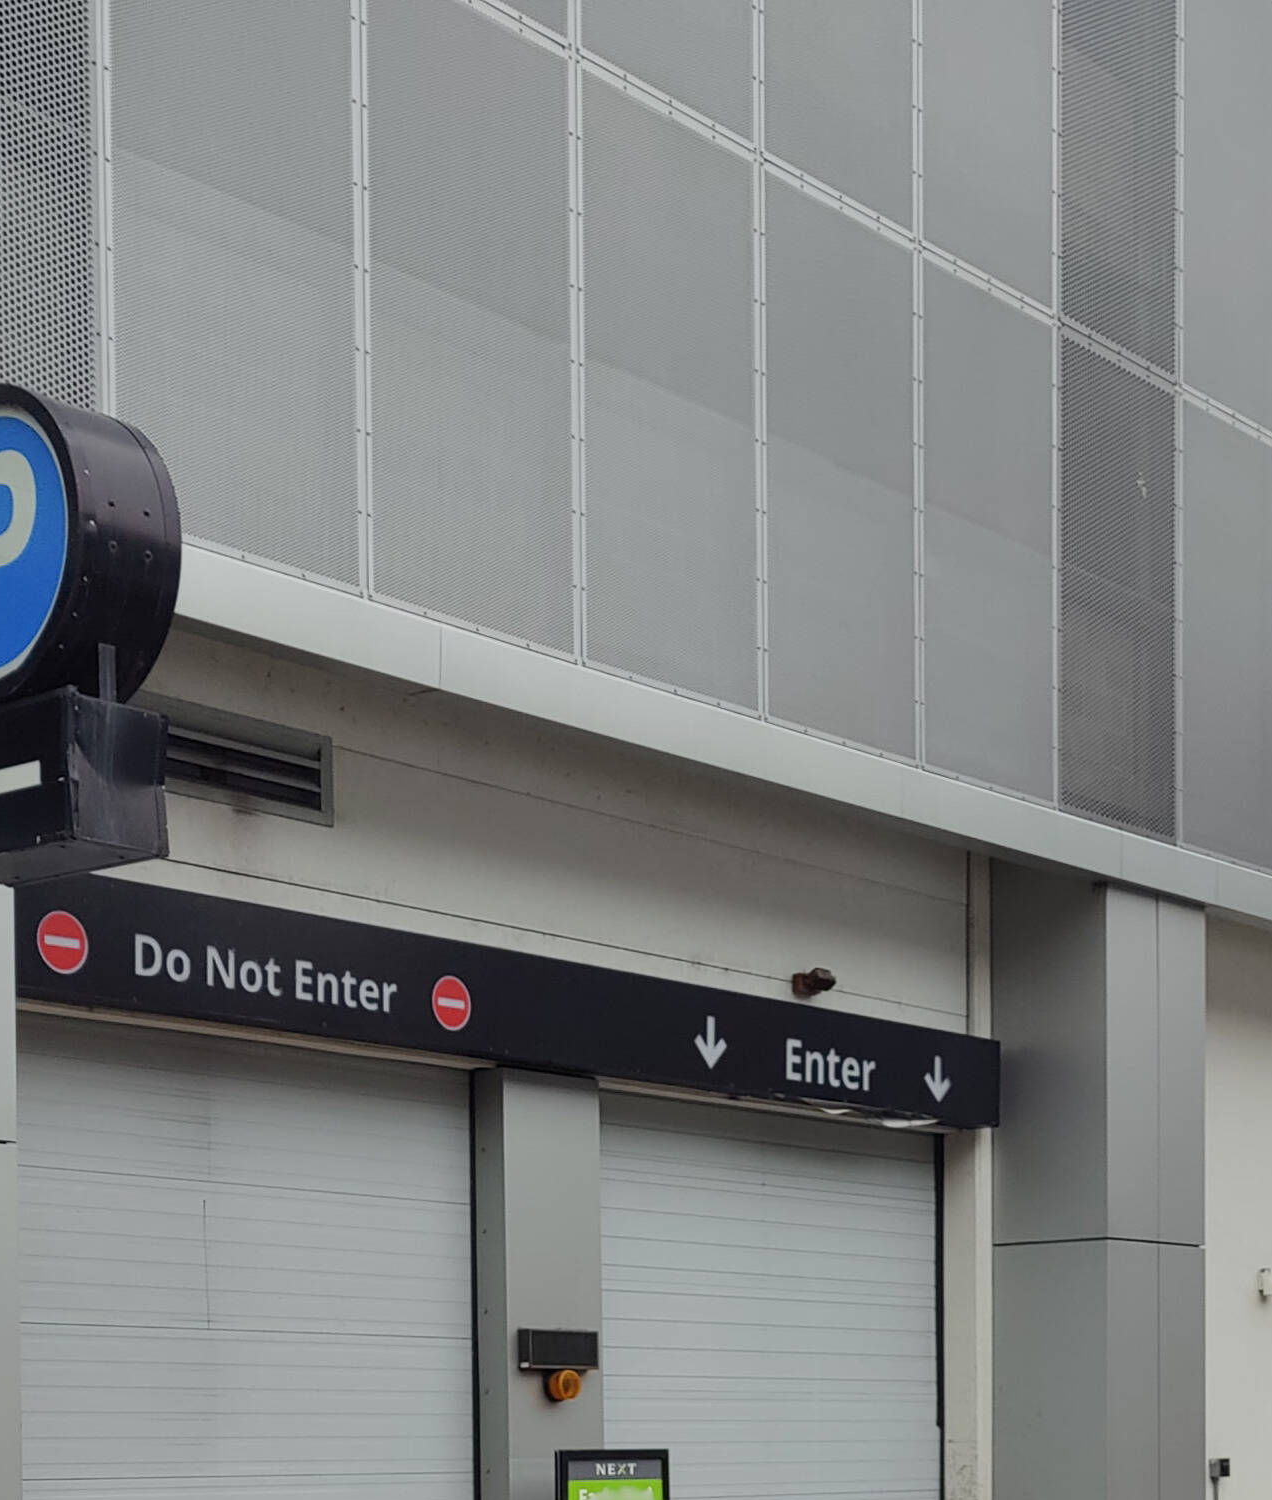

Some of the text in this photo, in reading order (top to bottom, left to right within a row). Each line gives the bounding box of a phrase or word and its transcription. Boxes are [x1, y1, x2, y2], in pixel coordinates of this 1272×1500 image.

[134, 933, 398, 1013] Do Not Enter
[785, 1037, 877, 1092] Enter
[595, 1463, 637, 1476] NEXT
